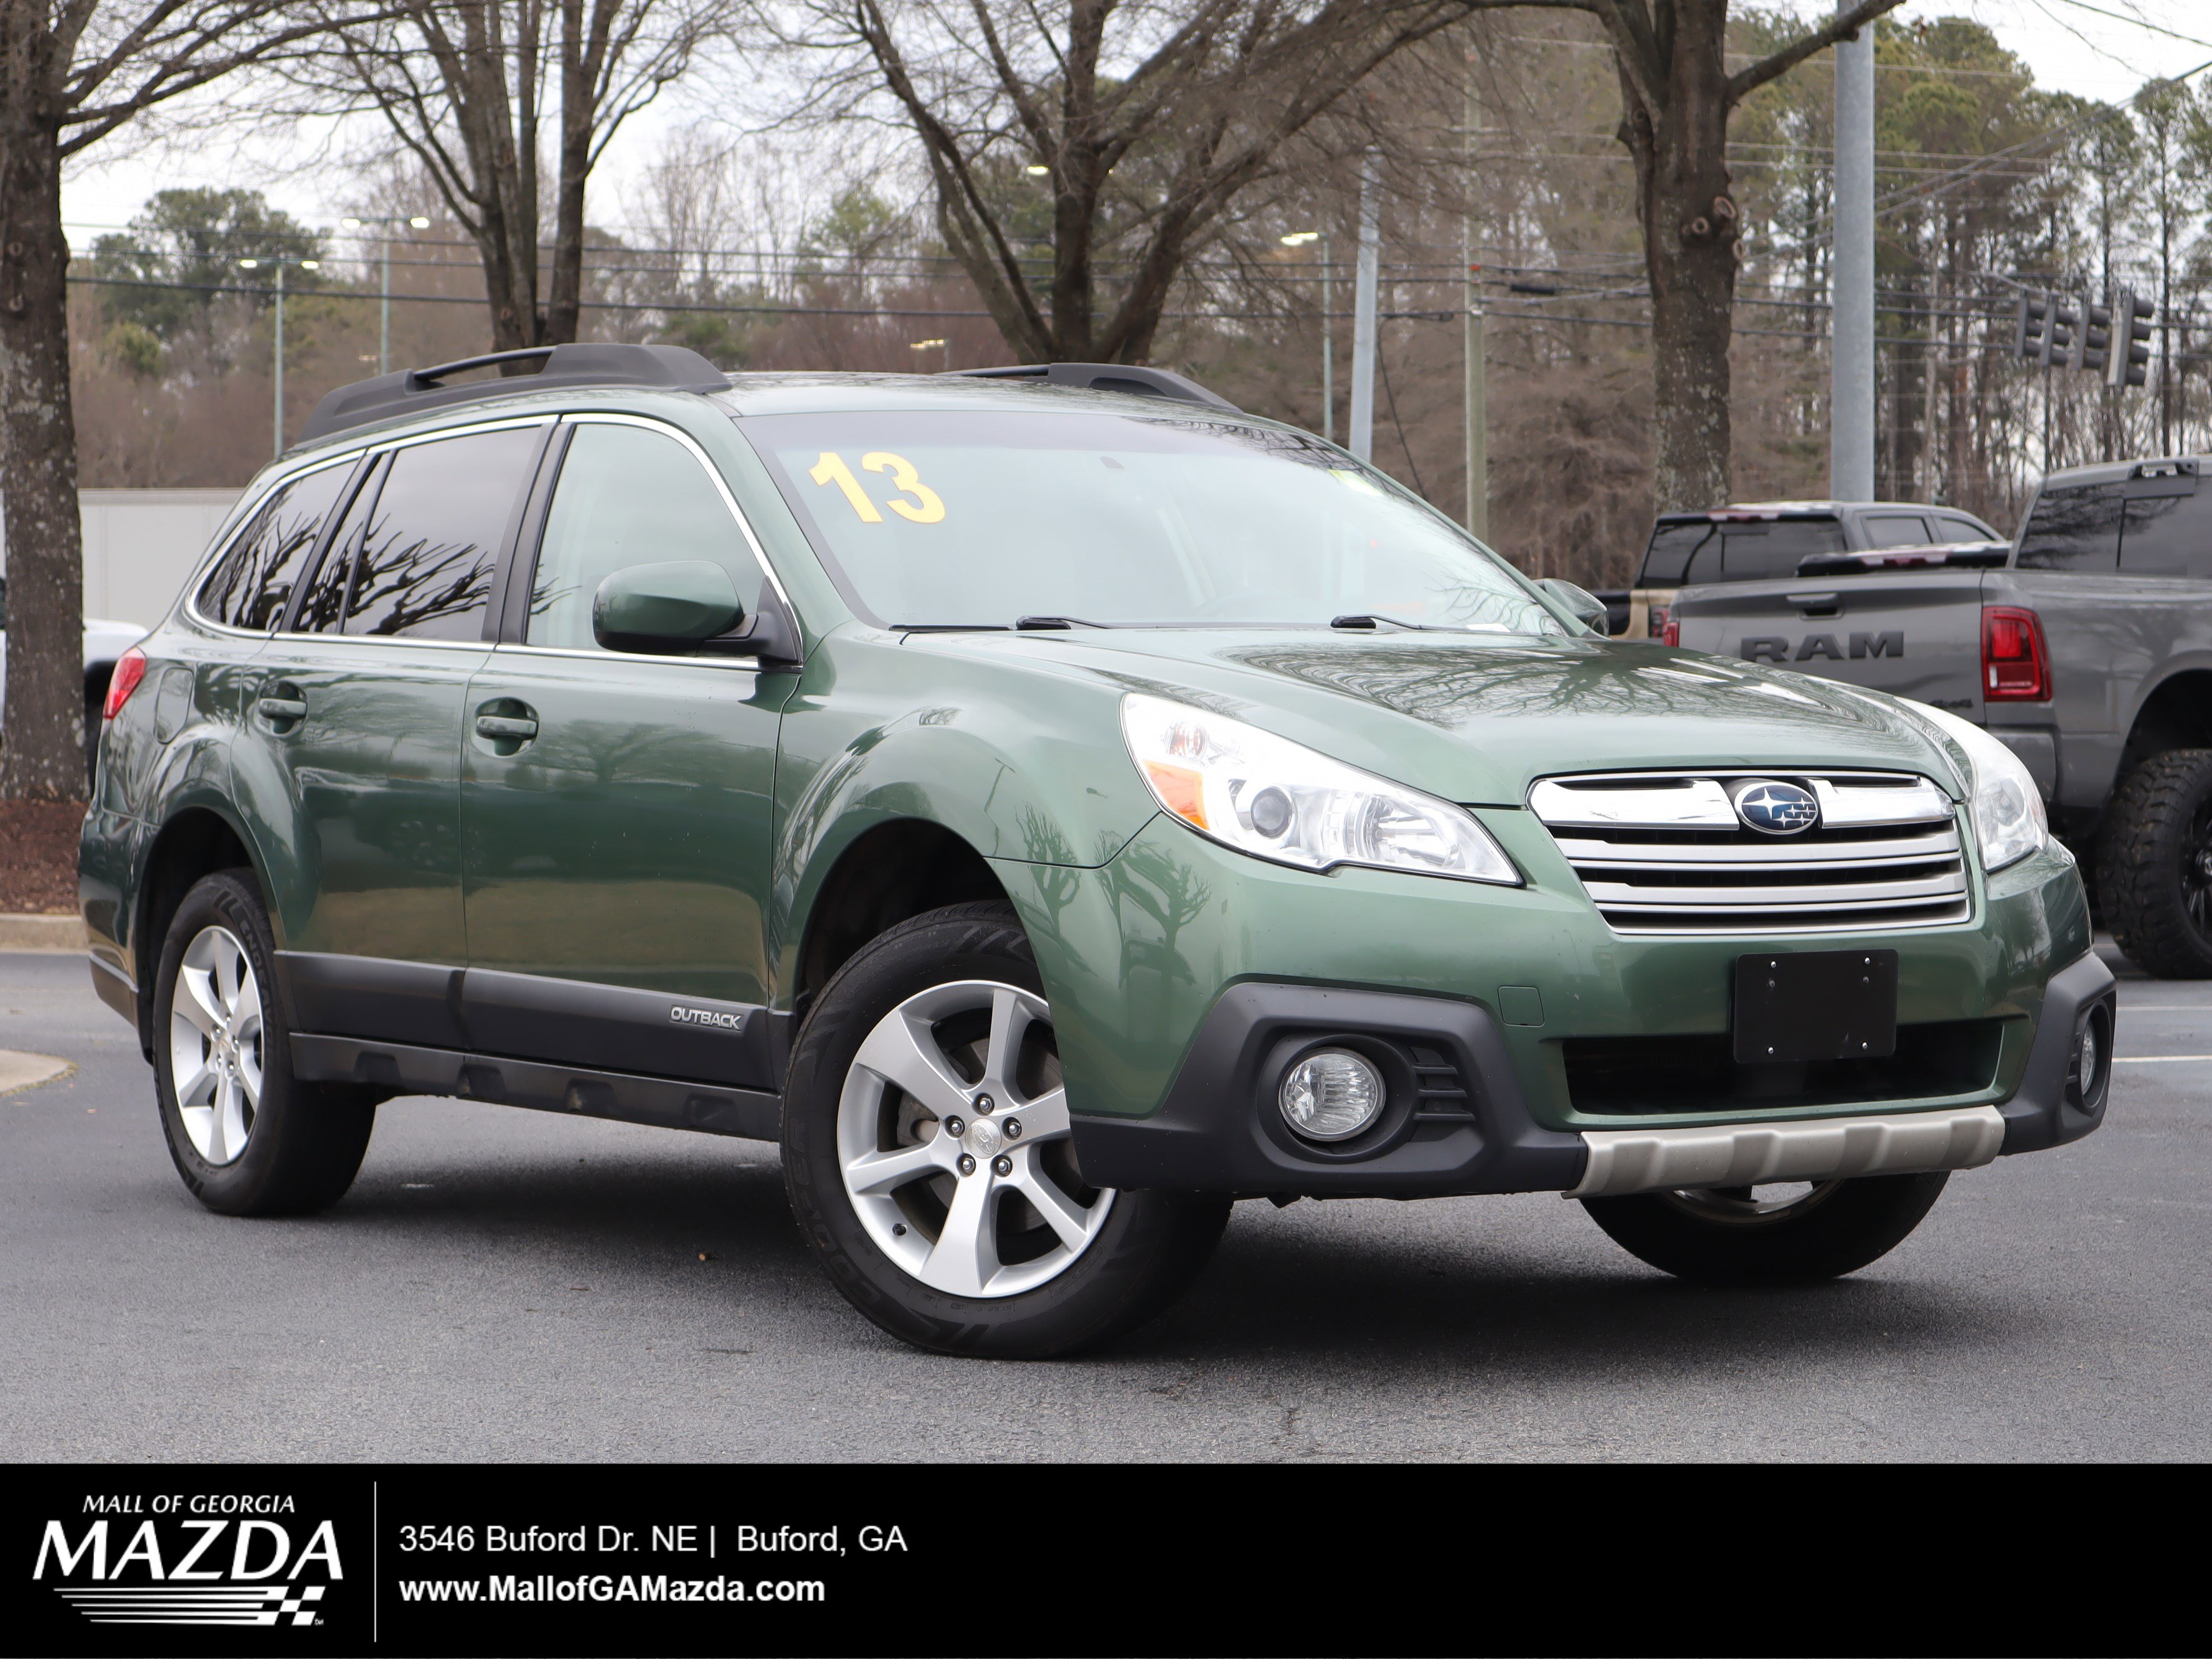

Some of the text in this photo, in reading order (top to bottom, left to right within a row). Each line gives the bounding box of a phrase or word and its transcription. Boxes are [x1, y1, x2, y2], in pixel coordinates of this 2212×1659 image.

[809, 451, 945, 525] 13
[1741, 630, 1904, 662] RAM
[671, 1006, 741, 1029] OUTBACK
